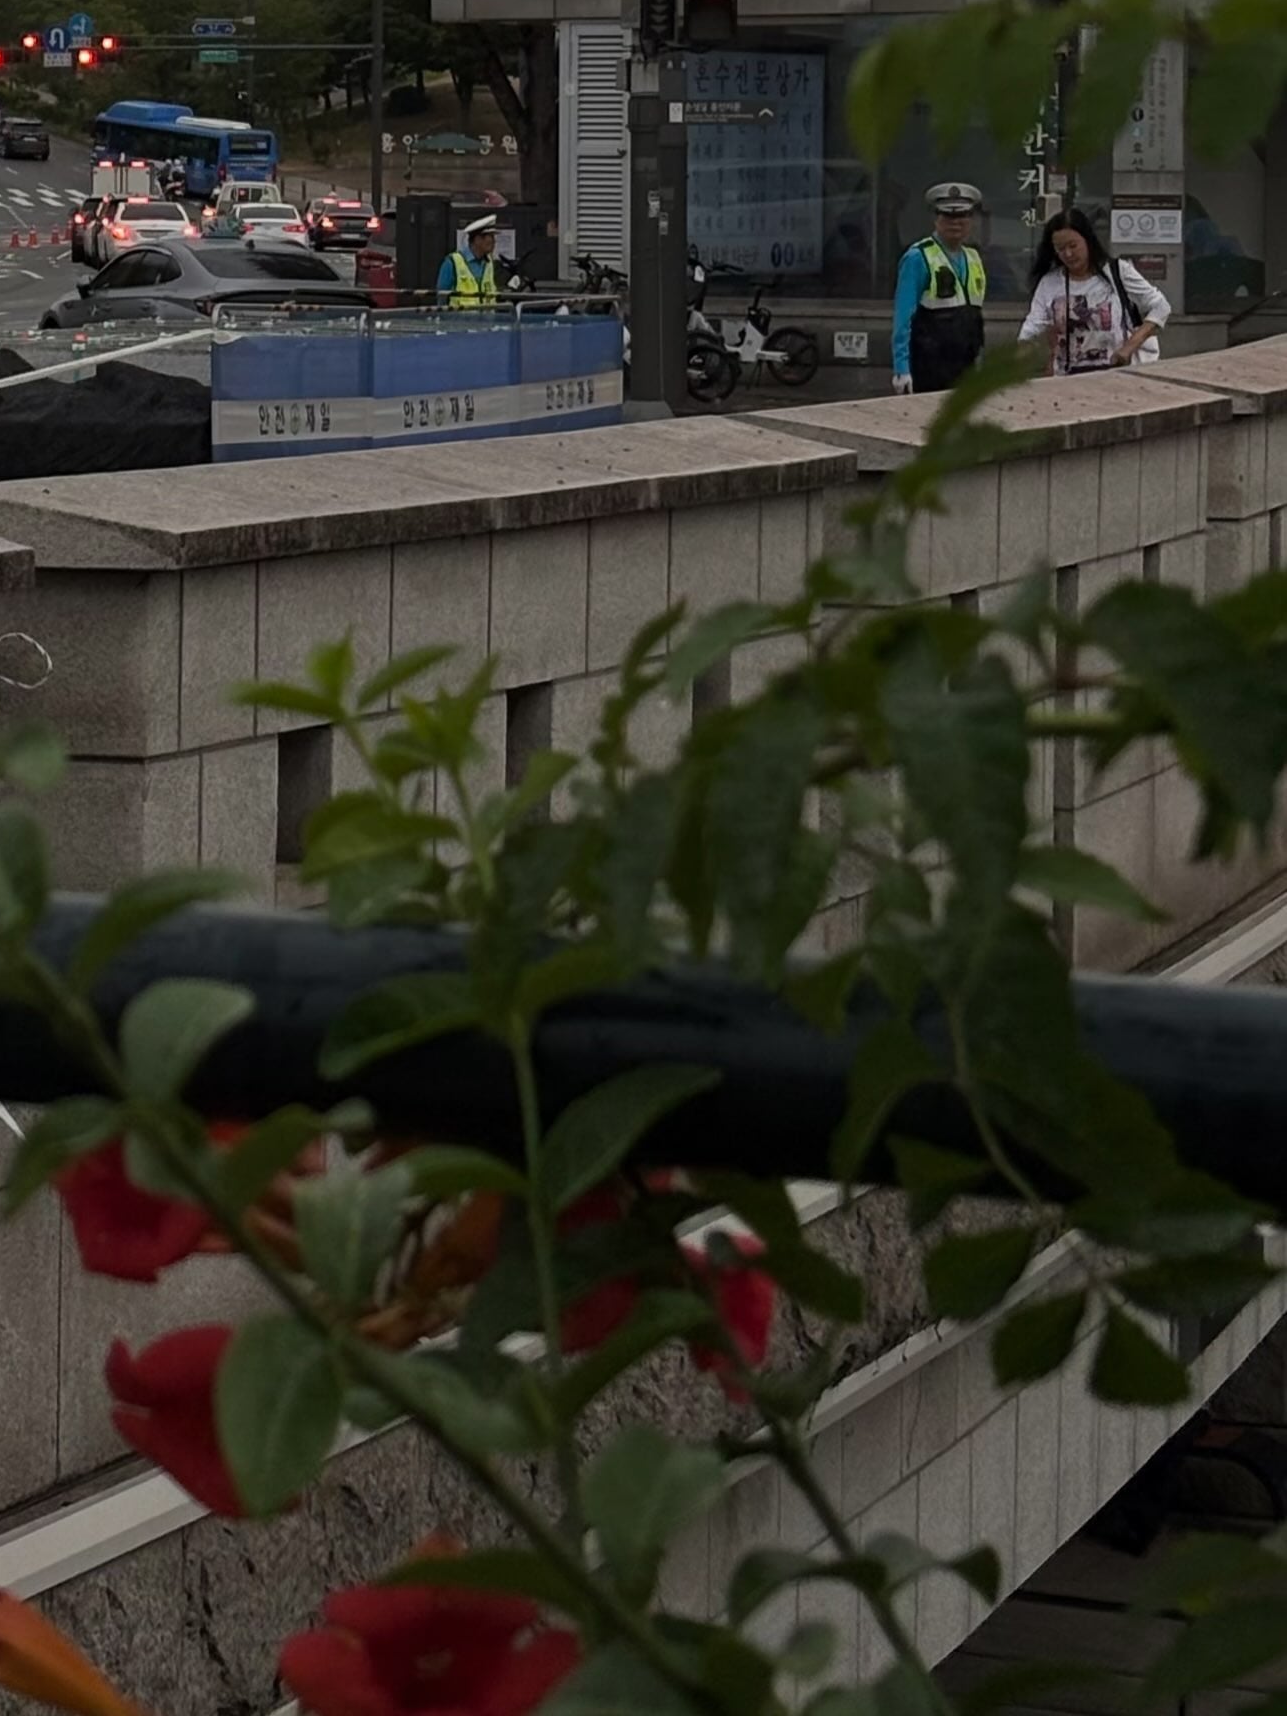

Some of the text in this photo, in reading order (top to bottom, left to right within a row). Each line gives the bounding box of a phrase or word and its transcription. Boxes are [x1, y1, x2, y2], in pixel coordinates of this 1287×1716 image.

[695, 59, 810, 97] 혼수전문상가
[381, 132, 519, 155] 흥인공원
[258, 401, 331, 436] 안전 제일
[403, 394, 476, 429] 안전 제일
